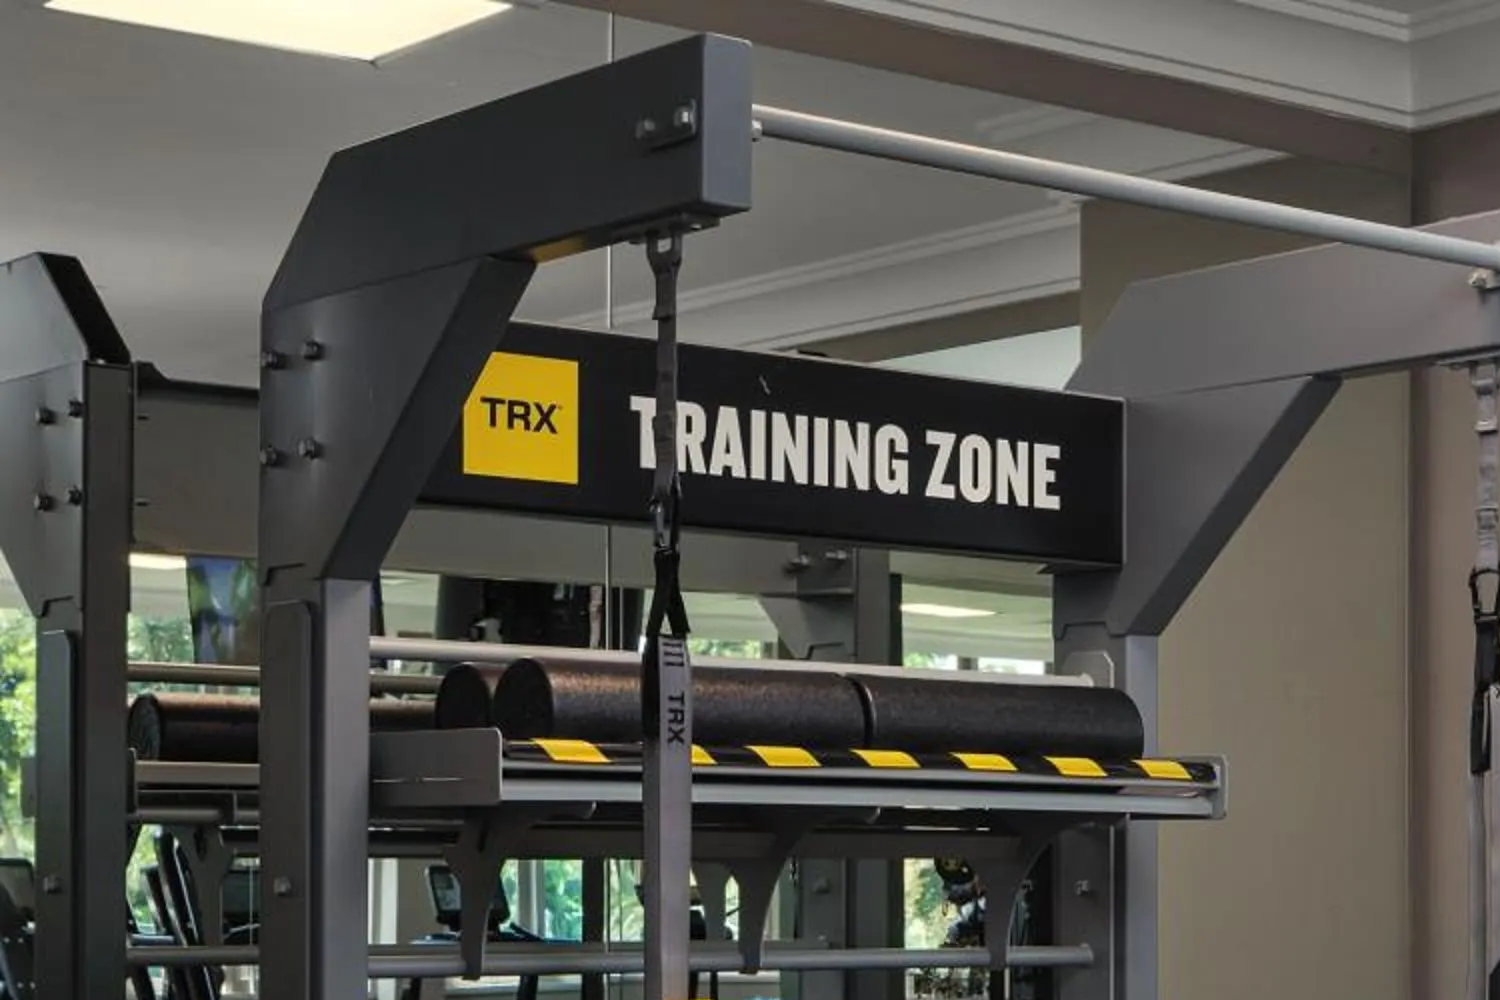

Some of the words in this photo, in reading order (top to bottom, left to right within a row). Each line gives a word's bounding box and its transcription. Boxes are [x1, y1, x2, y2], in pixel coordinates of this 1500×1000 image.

[480, 397, 558, 435] TRX
[629, 394, 909, 496] TRAINING
[925, 430, 1061, 510] ZONE
[667, 691, 686, 744] TRX
